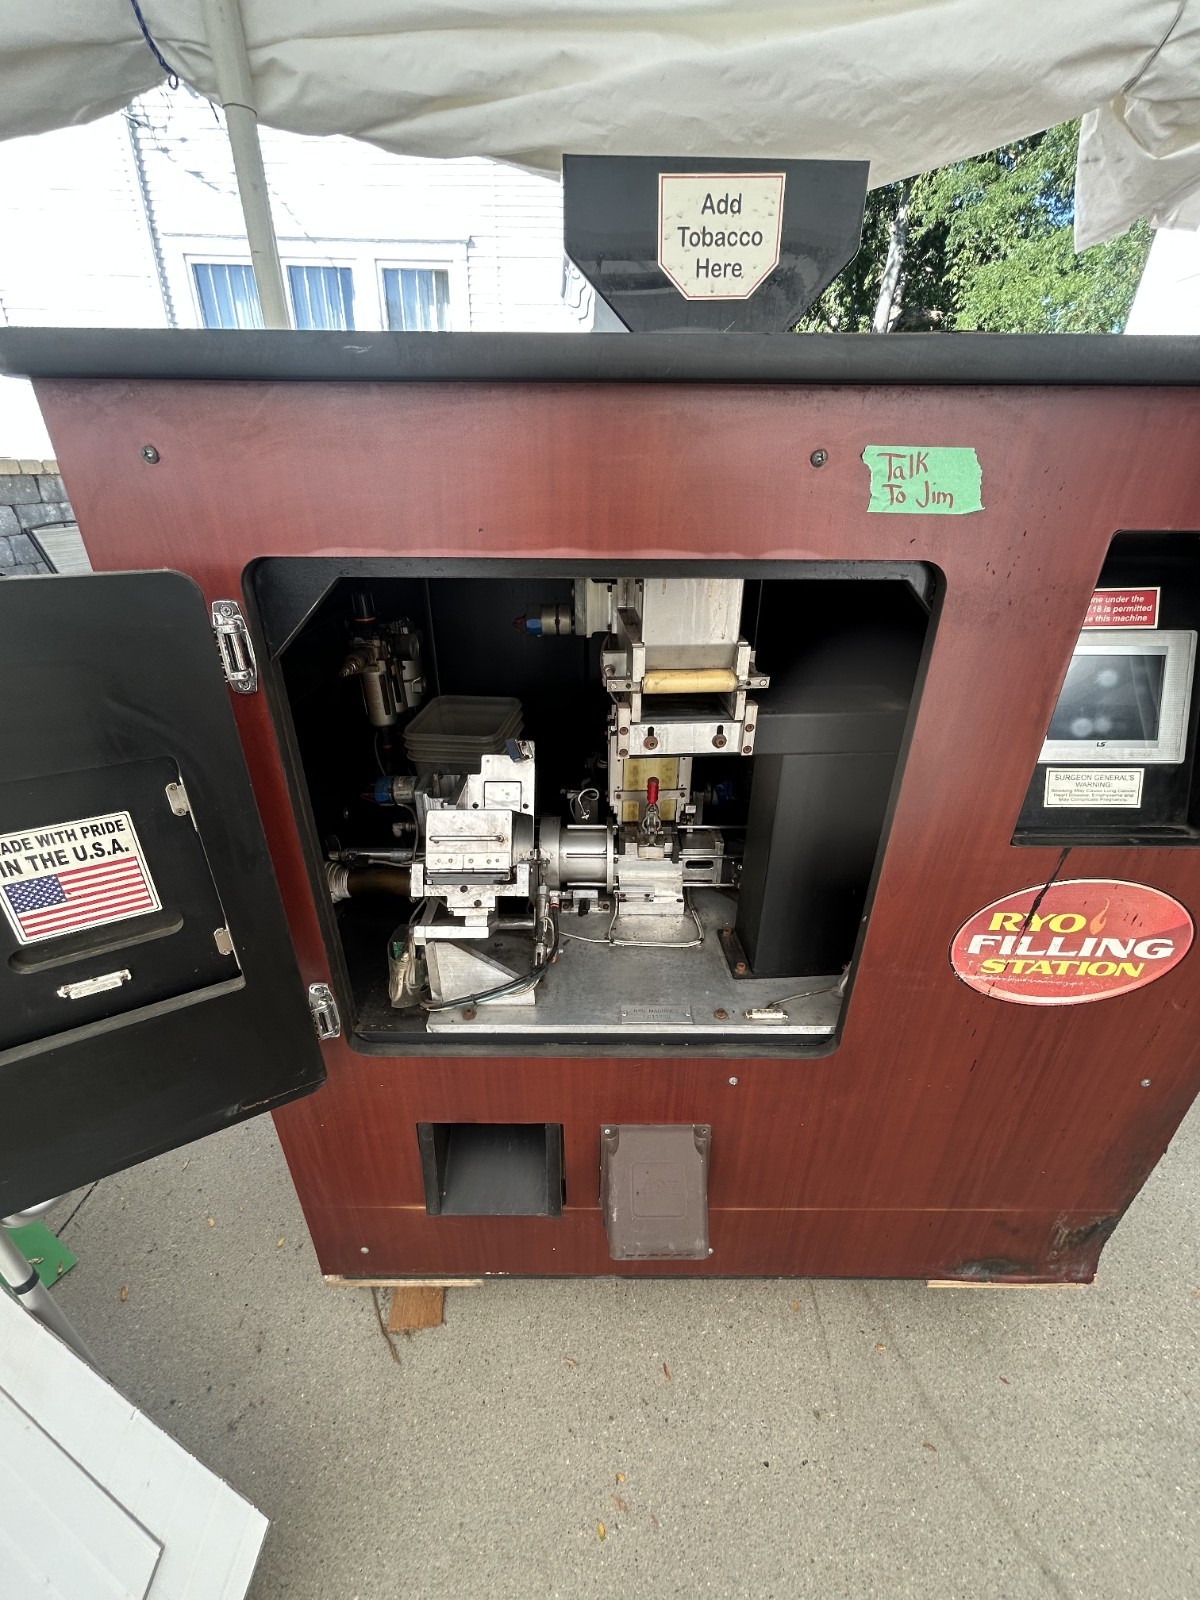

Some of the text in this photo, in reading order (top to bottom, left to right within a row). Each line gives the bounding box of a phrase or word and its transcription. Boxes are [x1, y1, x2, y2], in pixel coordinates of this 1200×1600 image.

[701, 193, 742, 215] Add
[677, 226, 763, 247] Tobacco
[696, 258, 743, 278] Here
[882, 480, 954, 508] To Jim
[1103, 605, 1111, 613] is
[1112, 604, 1152, 613] permitted
[1132, 594, 1144, 602] the
[1095, 614, 1111, 622] this
[1112, 614, 1147, 622] machine
[0, 819, 126, 857] ADE WITH PRIDE
[0, 838, 130, 878] IN THE U.S.A.
[988, 912, 1087, 933] RYO
[967, 934, 1176, 960] FILLING
[980, 959, 1145, 978] STATION
